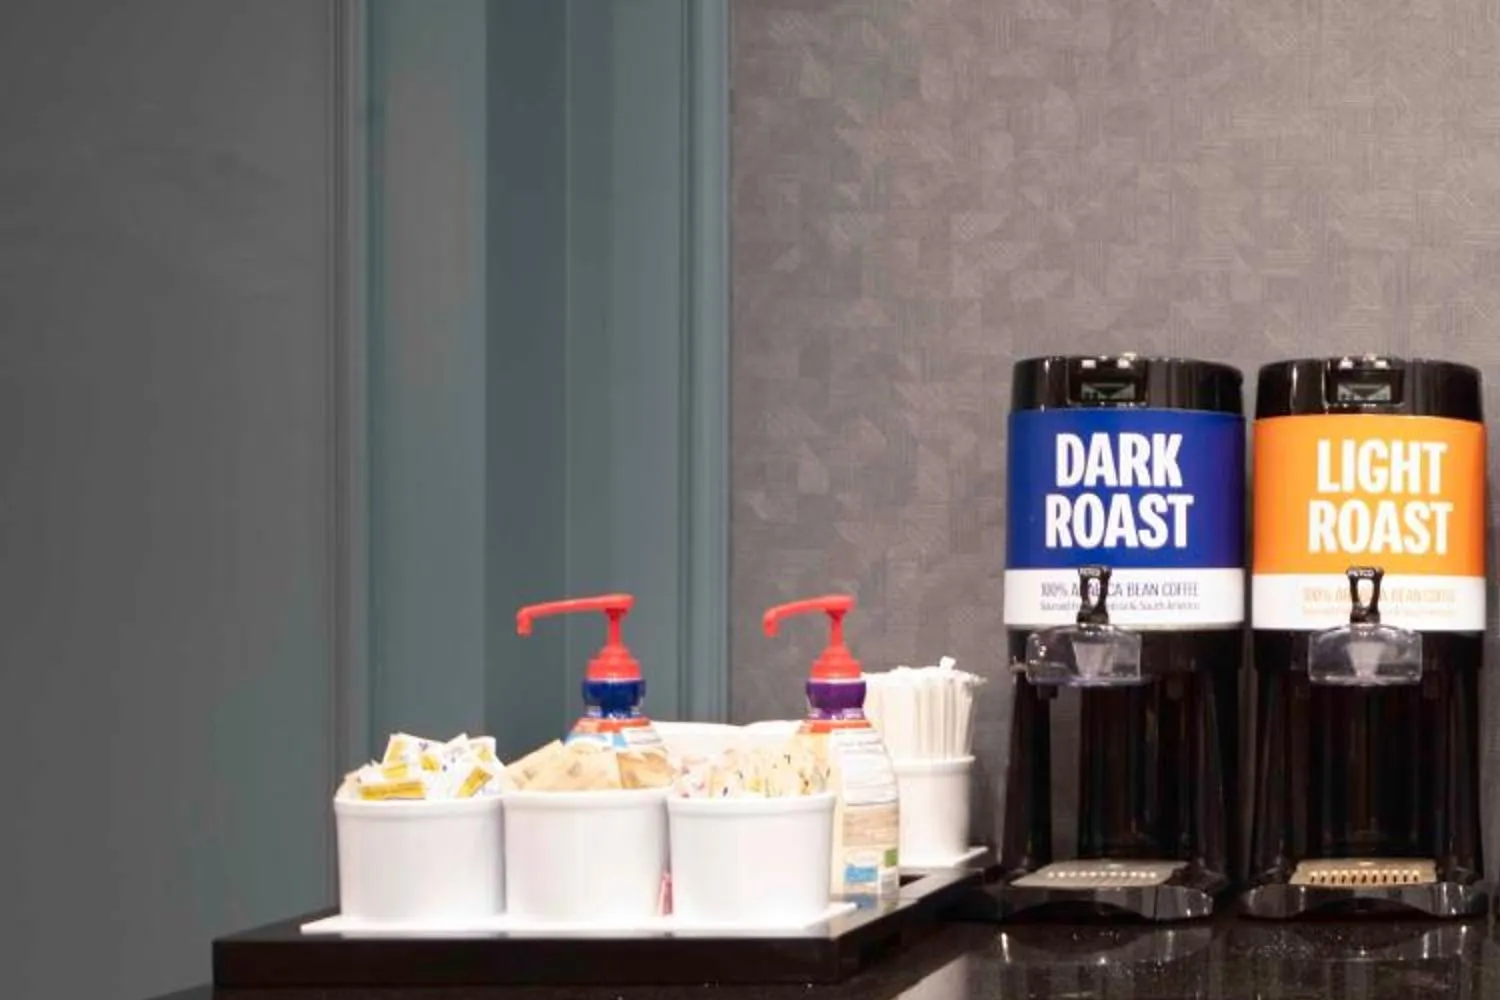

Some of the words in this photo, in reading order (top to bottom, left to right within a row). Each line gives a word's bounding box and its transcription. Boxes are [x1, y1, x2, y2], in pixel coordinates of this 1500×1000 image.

[1055, 432, 1183, 488] DARK
[1316, 438, 1448, 494] LIGHT
[1045, 493, 1194, 549] ROAST
[1307, 499, 1453, 555] ROAST
[1127, 582, 1159, 597] BEAN
[1162, 582, 1200, 597] COFFEE
